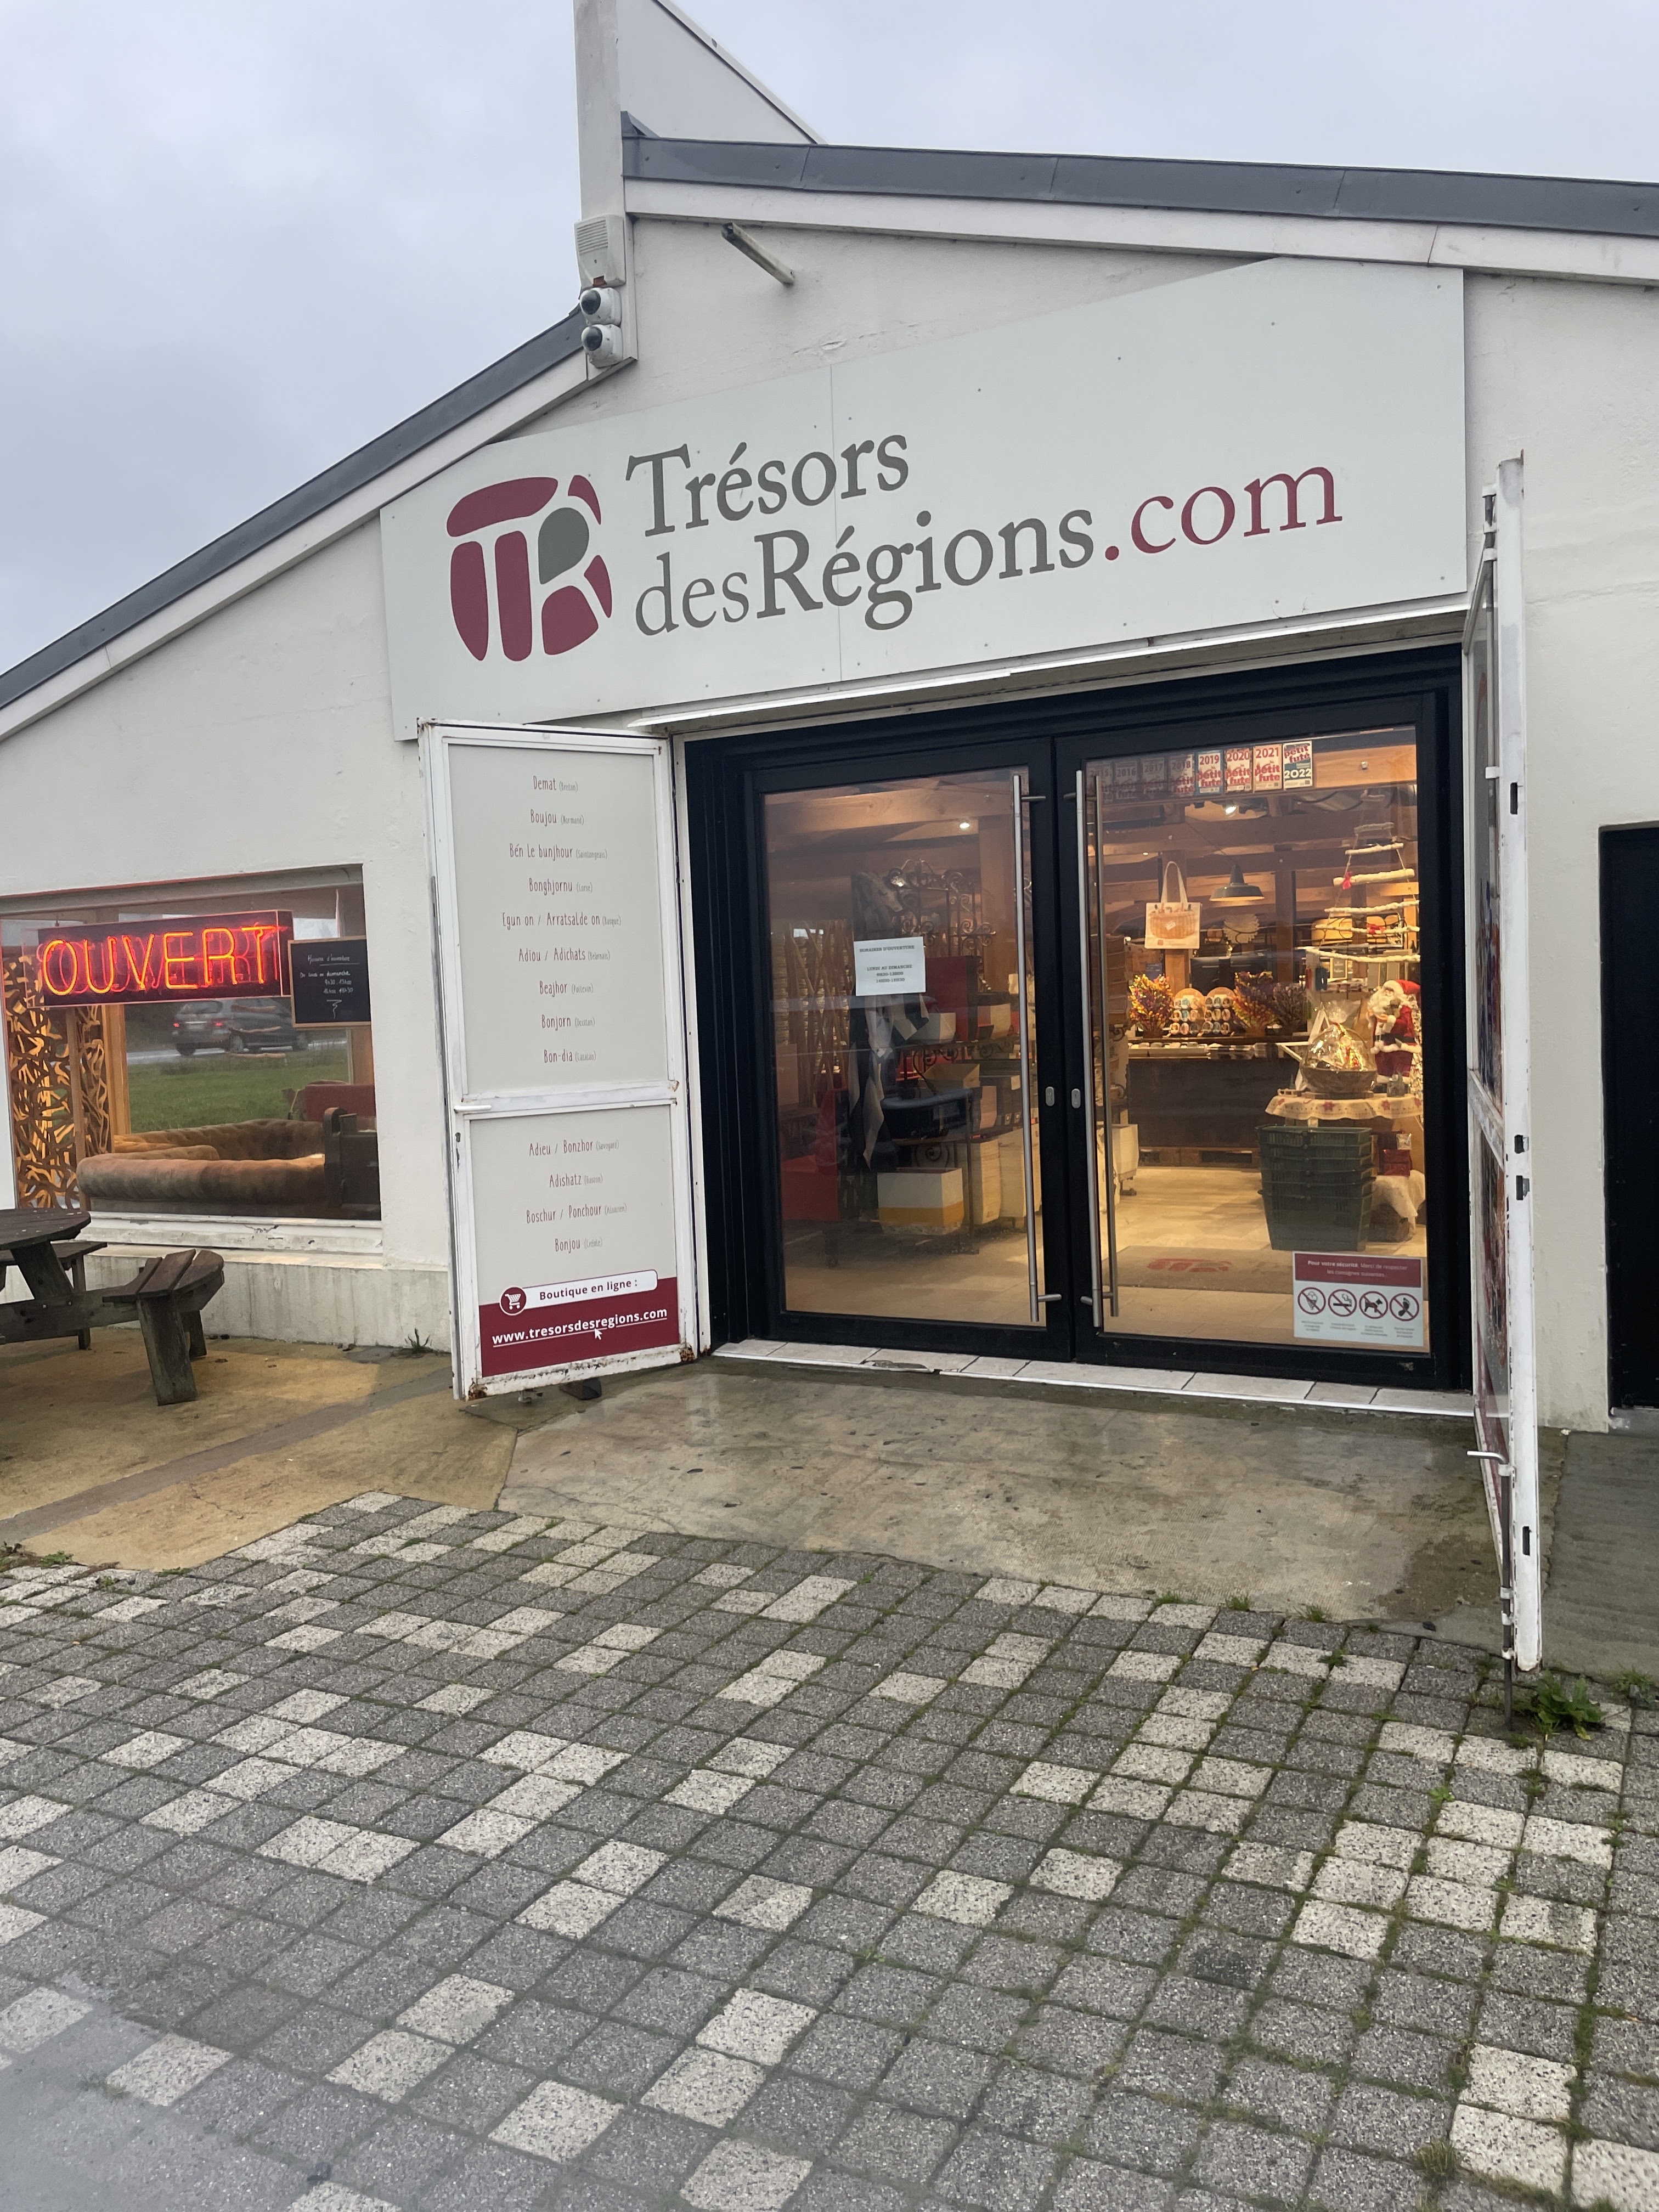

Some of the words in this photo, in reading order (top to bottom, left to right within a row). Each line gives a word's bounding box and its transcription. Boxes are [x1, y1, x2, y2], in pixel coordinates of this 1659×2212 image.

[626, 435, 909, 537] Trésors
[1227, 751, 1250, 761] 2020
[1255, 747, 1279, 758] 2021
[1284, 744, 1309, 758] petit
[1199, 754, 1220, 765] 2019
[1197, 769, 1222, 781] petit
[1226, 768, 1252, 779] petit
[1255, 764, 1280, 776] petit
[1284, 769, 1311, 778] 2022
[533, 776, 556, 791] Demat
[531, 809, 557, 827] Boujou
[510, 843, 523, 857] Bén
[529, 877, 573, 896] Bonghjornu
[503, 912, 521, 930] Egun
[524, 916, 534, 926] on
[546, 912, 588, 926] Arratsalde
[591, 915, 600, 925] on
[42, 924, 276, 996] OUVERT
[554, 947, 586, 961] Adichats
[539, 980, 567, 997] Beajhor
[541, 1014, 571, 1031] Bonjorn
[544, 1049, 573, 1063] Bon-dia
[529, 1142, 551, 1156] Adieu
[563, 1139, 593, 1154] Bonzhor
[549, 1173, 582, 1188] Adishatz
[526, 1209, 556, 1223] Boschur
[568, 1204, 602, 1218] Ponchour
[555, 1238, 580, 1254] Bonjou
[540, 1286, 588, 1301] Boutique
[591, 1284, 603, 1293] en
[606, 1278, 632, 1293] ligne
[492, 1308, 668, 1344] www.tresorsdesregions.com
